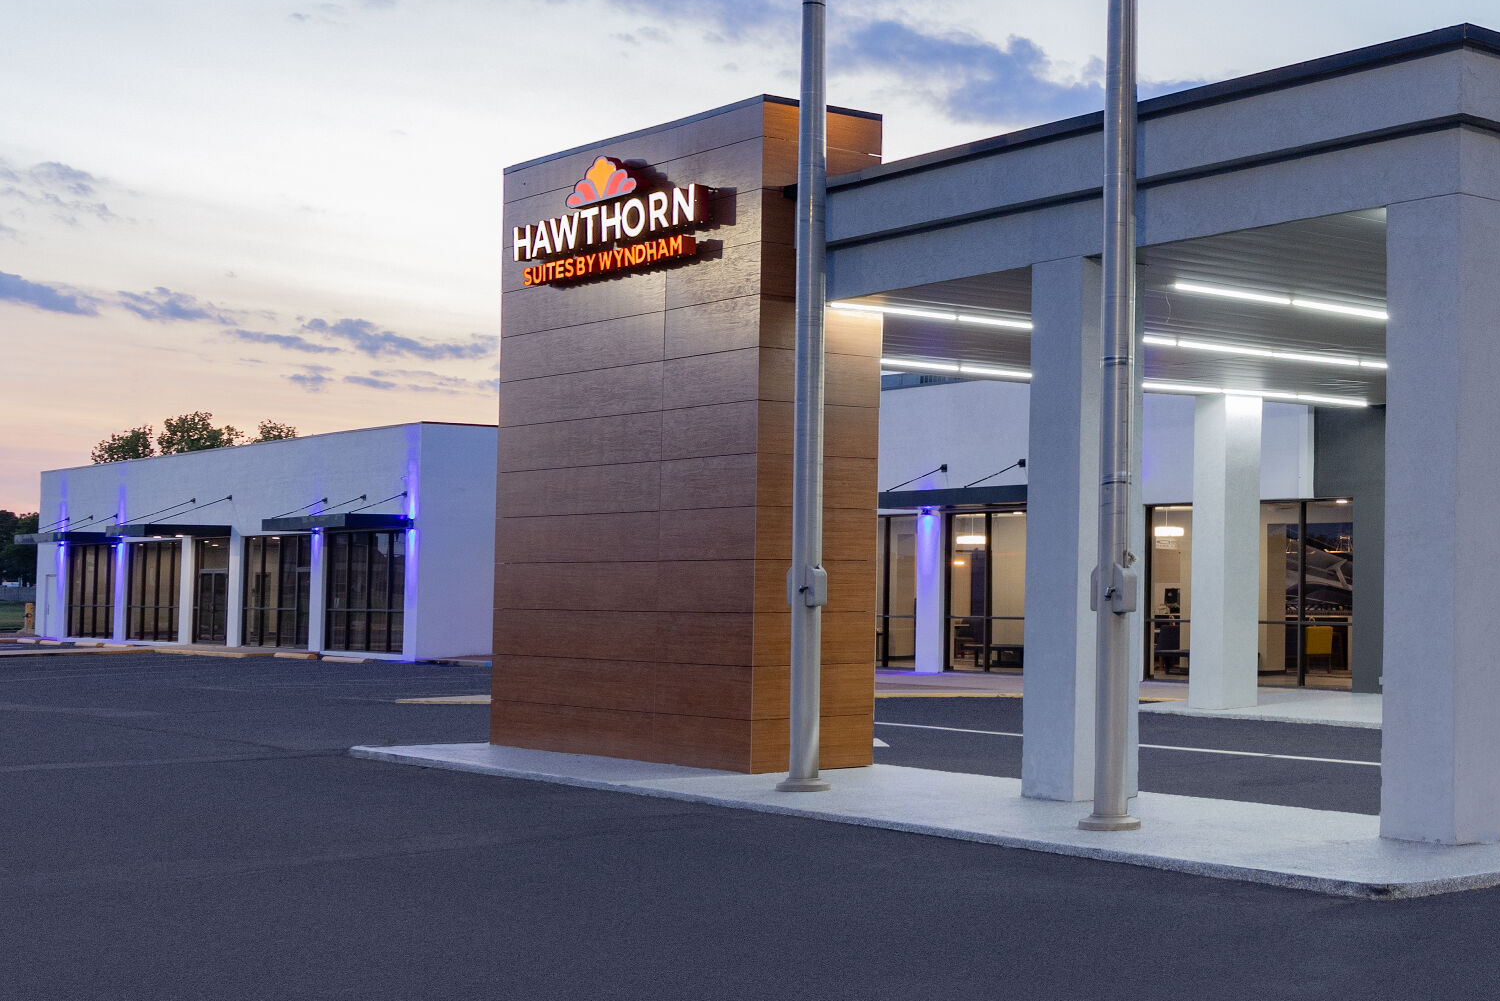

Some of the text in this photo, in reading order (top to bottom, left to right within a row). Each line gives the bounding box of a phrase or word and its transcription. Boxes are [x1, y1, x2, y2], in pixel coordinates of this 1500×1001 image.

[513, 183, 696, 261] HAWTHORN
[523, 234, 683, 286] SUITES BY WYNDHAM
